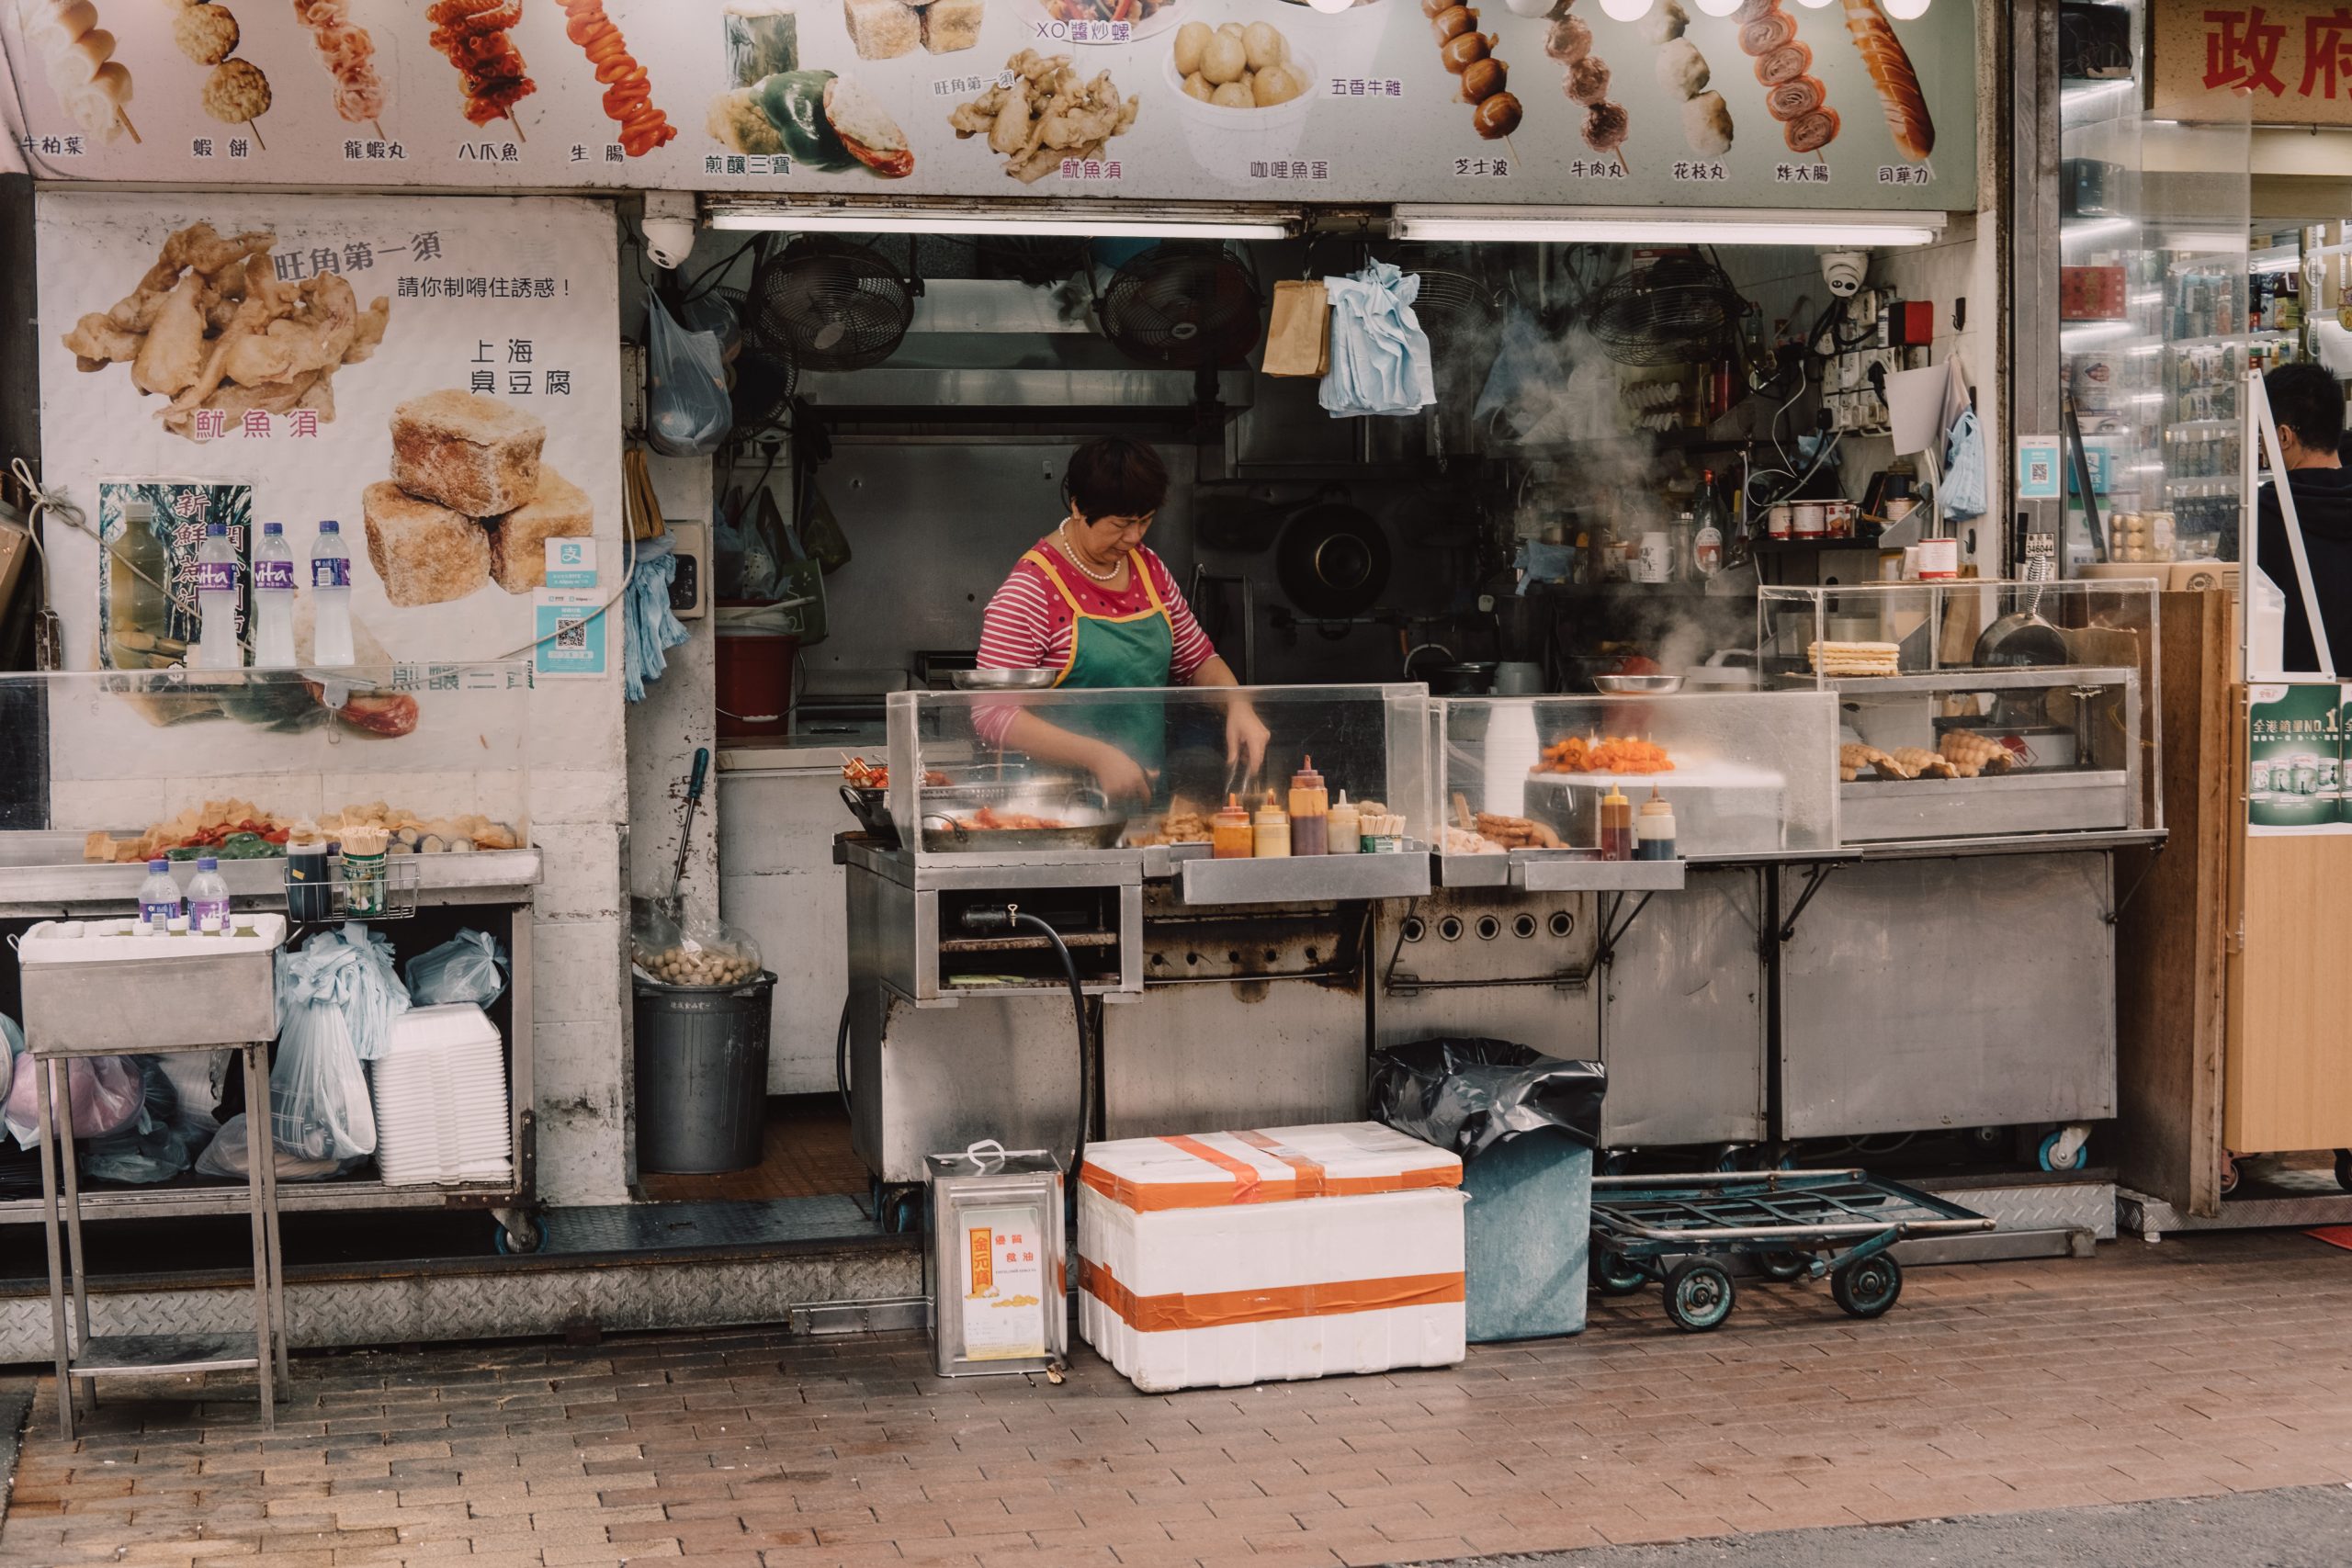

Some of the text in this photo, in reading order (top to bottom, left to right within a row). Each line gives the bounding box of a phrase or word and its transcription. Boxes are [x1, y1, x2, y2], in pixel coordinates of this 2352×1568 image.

[1036, 21, 1130, 41] XO醬炒螺
[933, 71, 1015, 96] 旺角第一須
[1331, 79, 1402, 96] 五香牛雜
[20, 135, 85, 155] 牛柏葉
[345, 140, 406, 159] 龍蝦丸
[458, 142, 520, 162] 八爪魚
[705, 155, 790, 175] 煎釀三寶
[1061, 160, 1123, 180] 魷魚須
[1454, 158, 1509, 177] 芝士波
[1571, 160, 1627, 179] 牛肉丸
[1673, 161, 1728, 180] 花枝丸
[1775, 164, 1829, 182] 炸大腸
[1878, 165, 1928, 185] 司華力
[275, 230, 443, 283] 旺角第一須
[470, 338, 533, 364] 上海
[470, 369, 571, 396] 臭豆腐
[195, 410, 319, 439] 魷魚須
[198, 563, 229, 584] vita
[254, 562, 288, 582] vita
